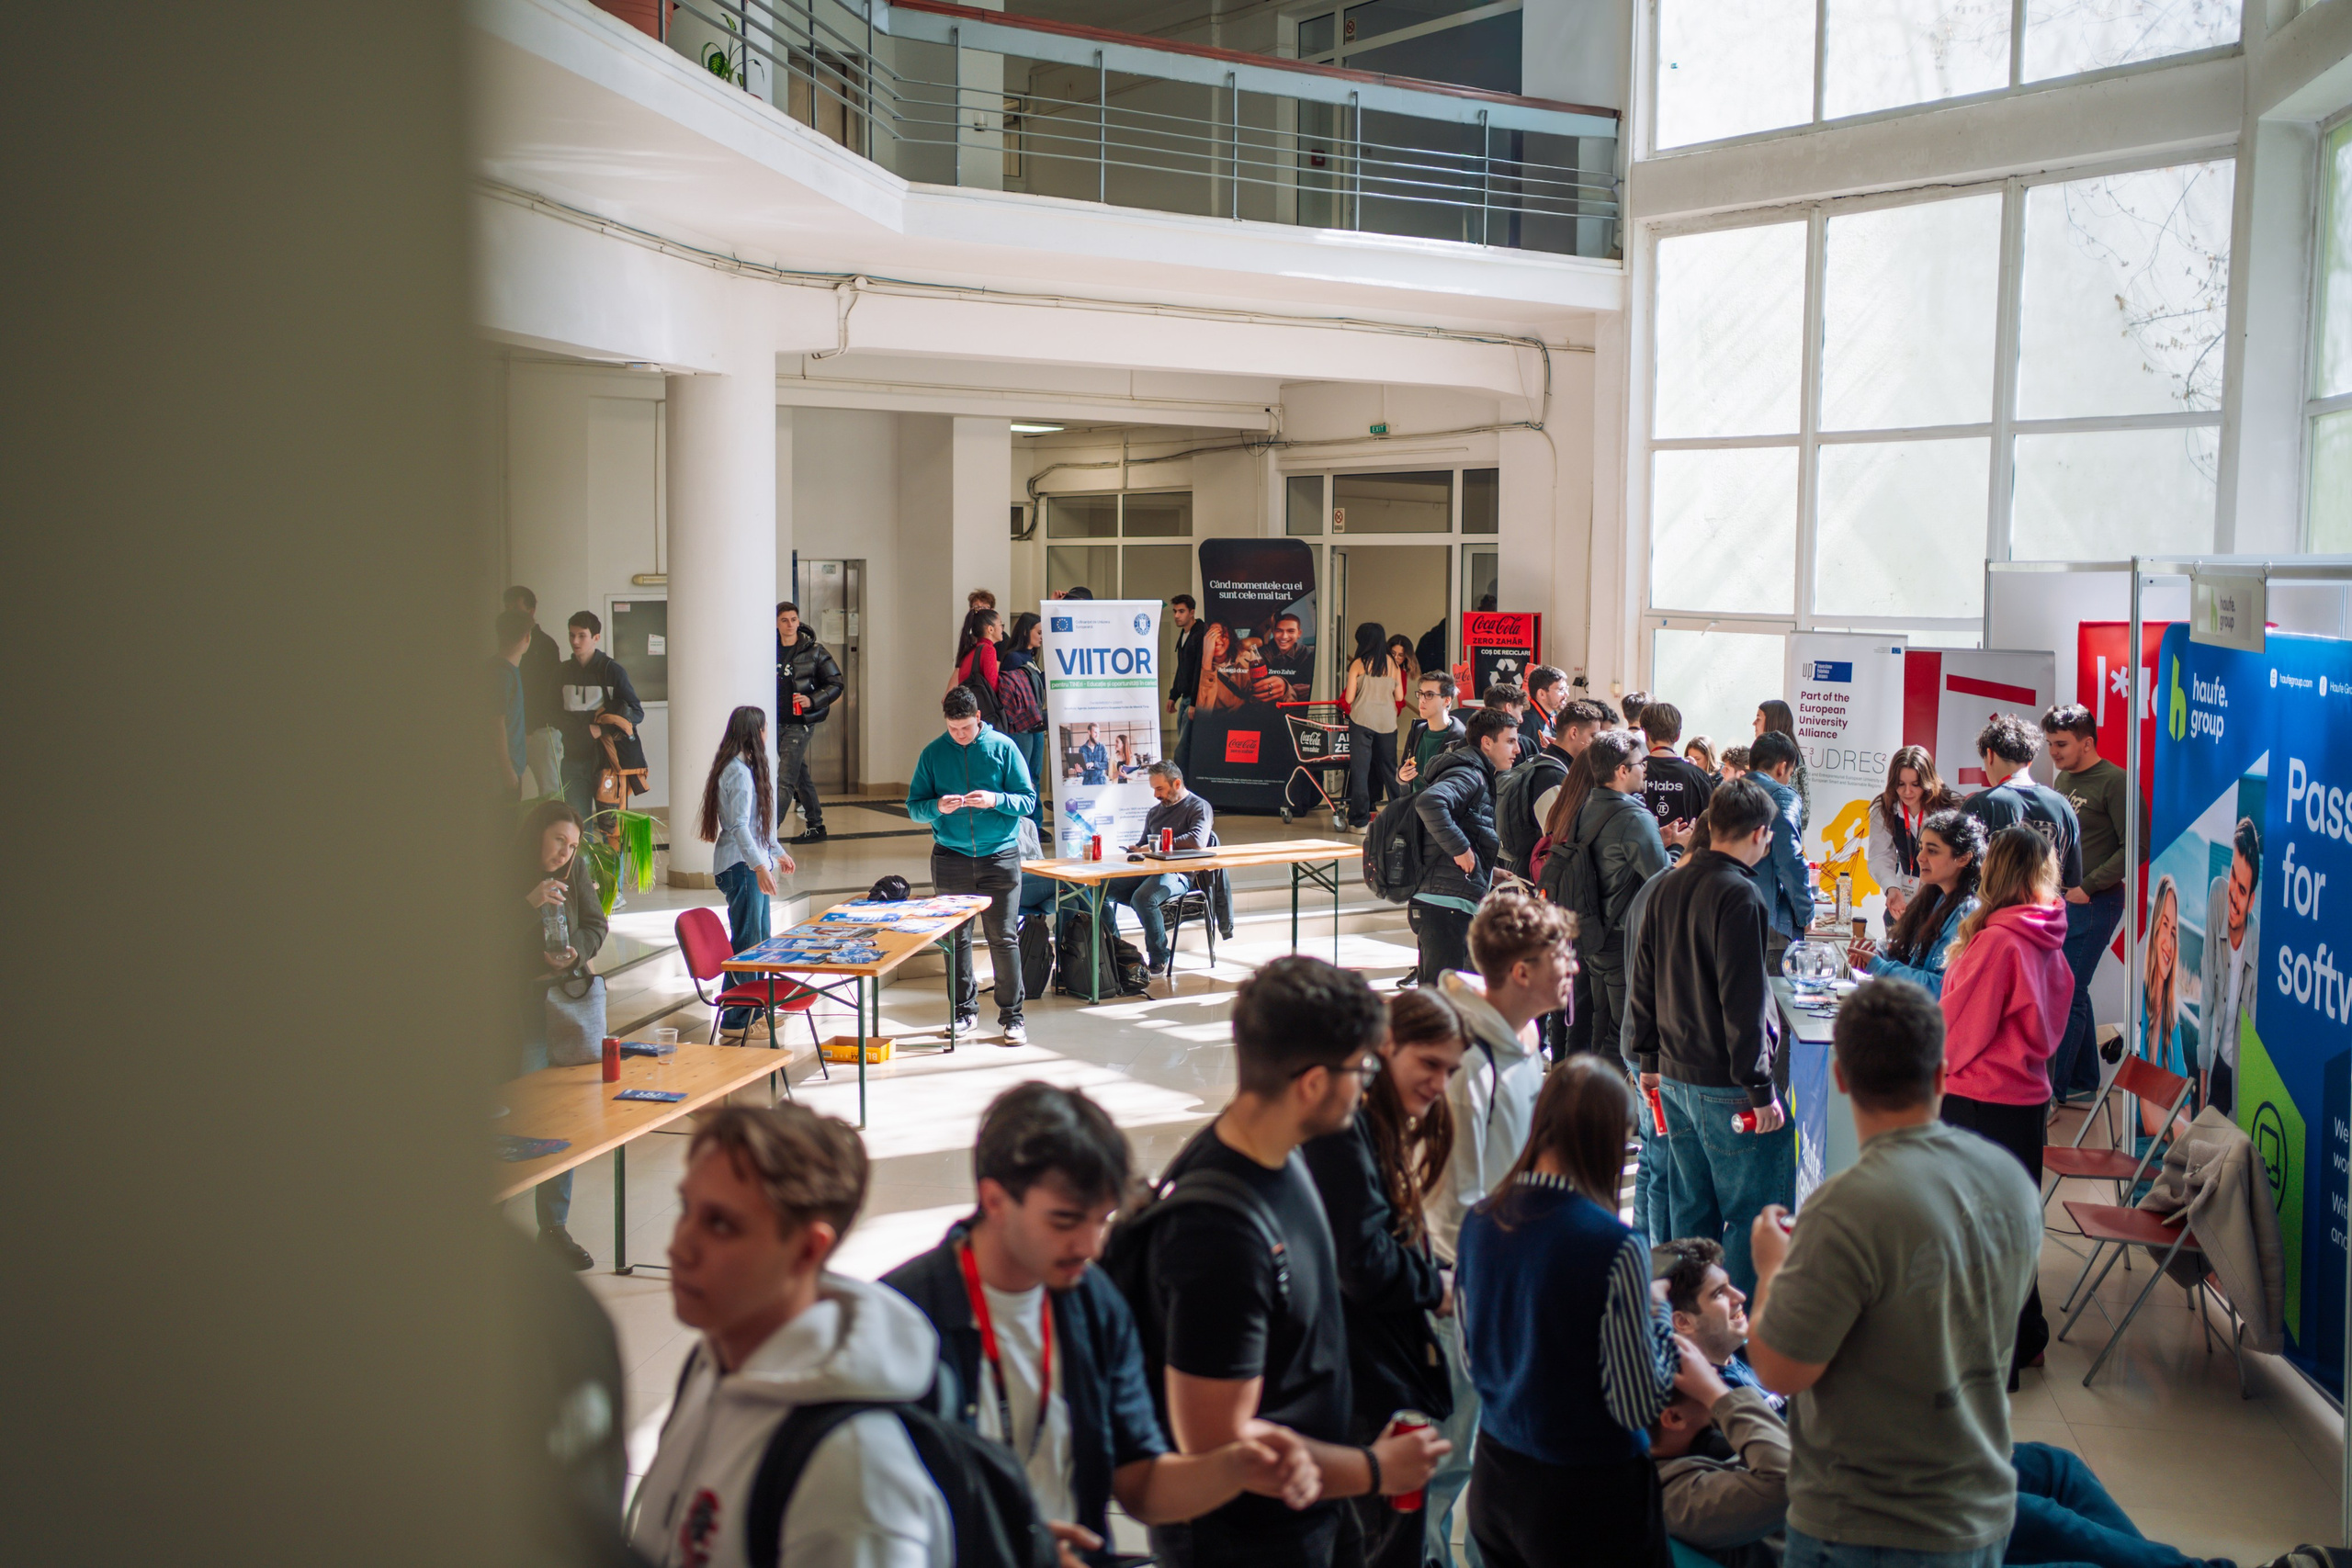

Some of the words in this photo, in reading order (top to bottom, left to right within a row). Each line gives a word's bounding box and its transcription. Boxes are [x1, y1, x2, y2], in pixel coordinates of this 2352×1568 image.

[1372, 425, 1385, 434] EXIT
[1209, 580, 1231, 589] Când
[1232, 581, 1281, 591] momentele
[1294, 581, 1303, 591] ei
[1238, 591, 1256, 600] cele
[1257, 592, 1273, 600] mai
[1274, 592, 1293, 601] tari.
[2219, 595, 2236, 613] haufe.
[2219, 615, 2234, 634] group
[1055, 647, 1152, 676] VIITOR
[2192, 671, 2228, 707] haufe.
[2279, 673, 2312, 689] haufegroup.com
[2330, 681, 2344, 694] Haufe
[1801, 691, 1821, 701] Part
[1823, 692, 1833, 702] of
[1834, 693, 1850, 703] the
[1800, 703, 1846, 716] European
[1799, 716, 1849, 730] University
[2190, 708, 2224, 744] group
[1798, 728, 1838, 739] Alliance
[2282, 841, 2326, 921] for
[2334, 1116, 2349, 1143] We
[2332, 1190, 2347, 1221] Wit
